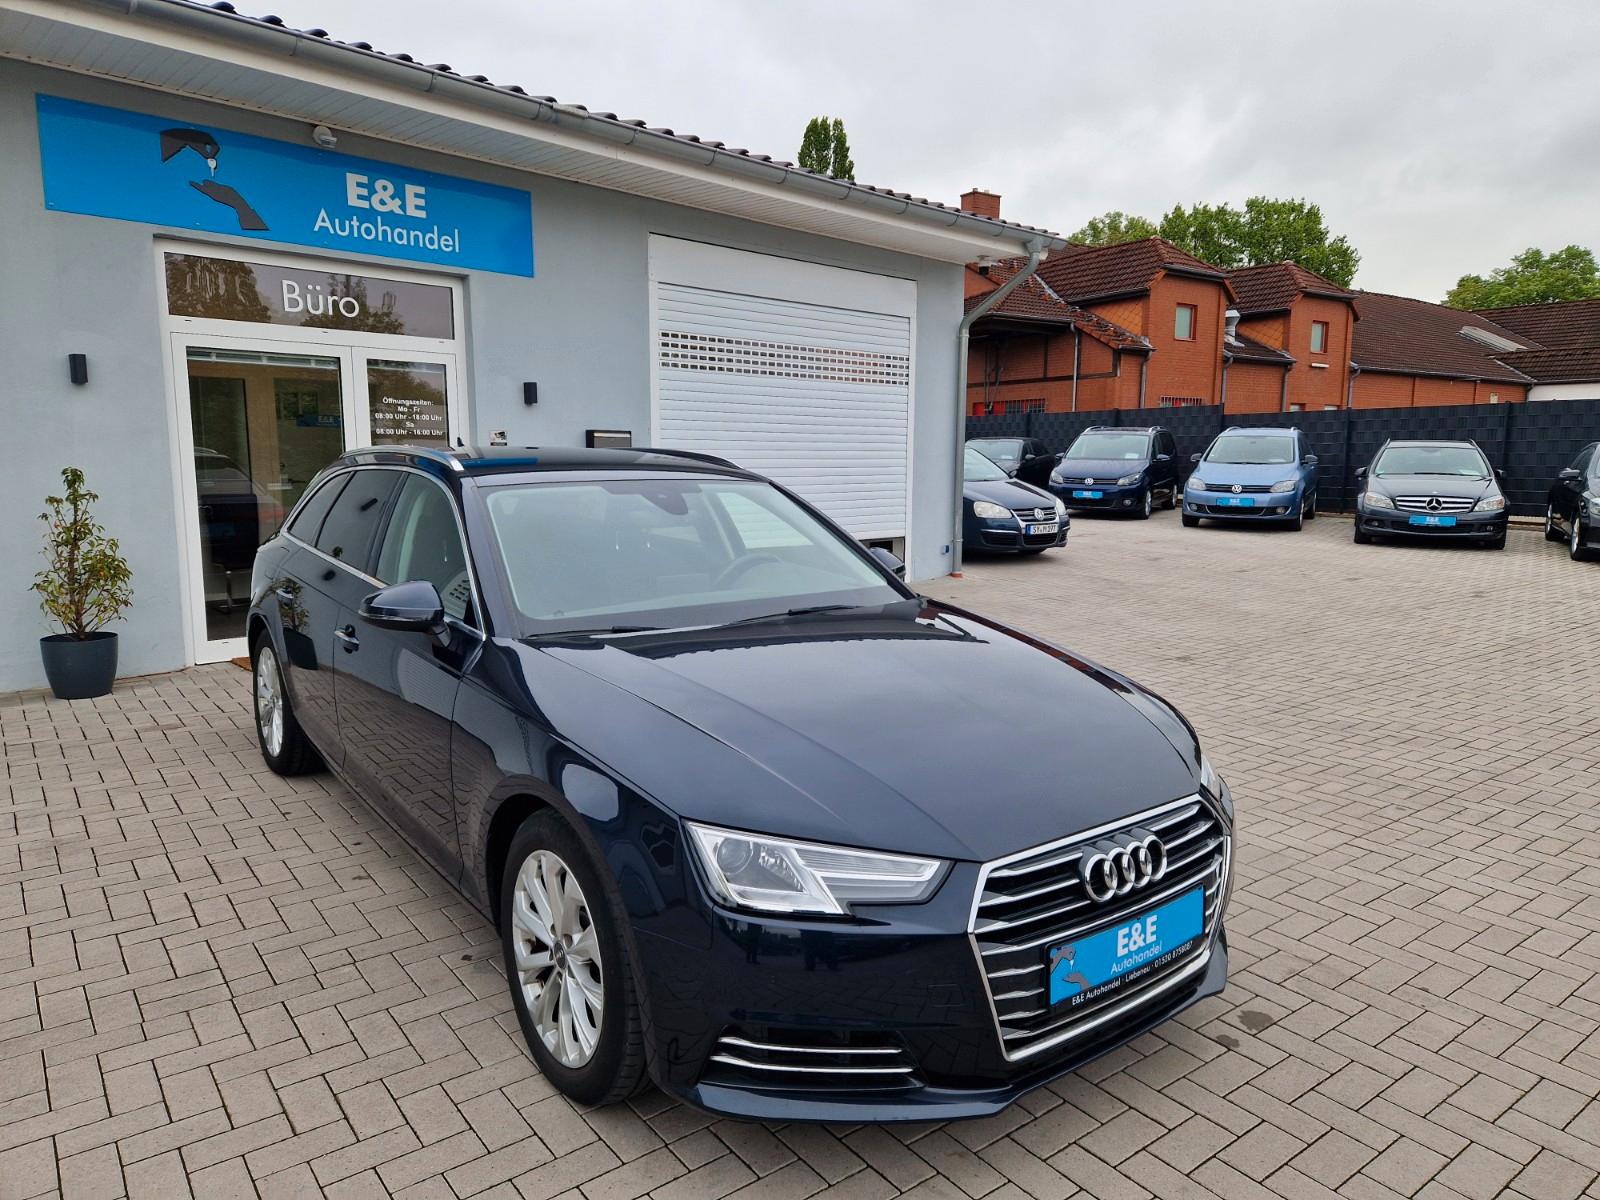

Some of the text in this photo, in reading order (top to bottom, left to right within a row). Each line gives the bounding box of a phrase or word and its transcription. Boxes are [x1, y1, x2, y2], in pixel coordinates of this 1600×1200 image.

[346, 173, 427, 218] E&E
[314, 208, 460, 252] Autohandel
[282, 279, 361, 318] Büro
[382, 396, 434, 406] Öffnungszeiten:
[1117, 915, 1158, 957] E&E
[1110, 943, 1162, 974] Autohandel
[1071, 993, 1085, 1006] E&E
[1085, 977, 1121, 1001] Autohandel
